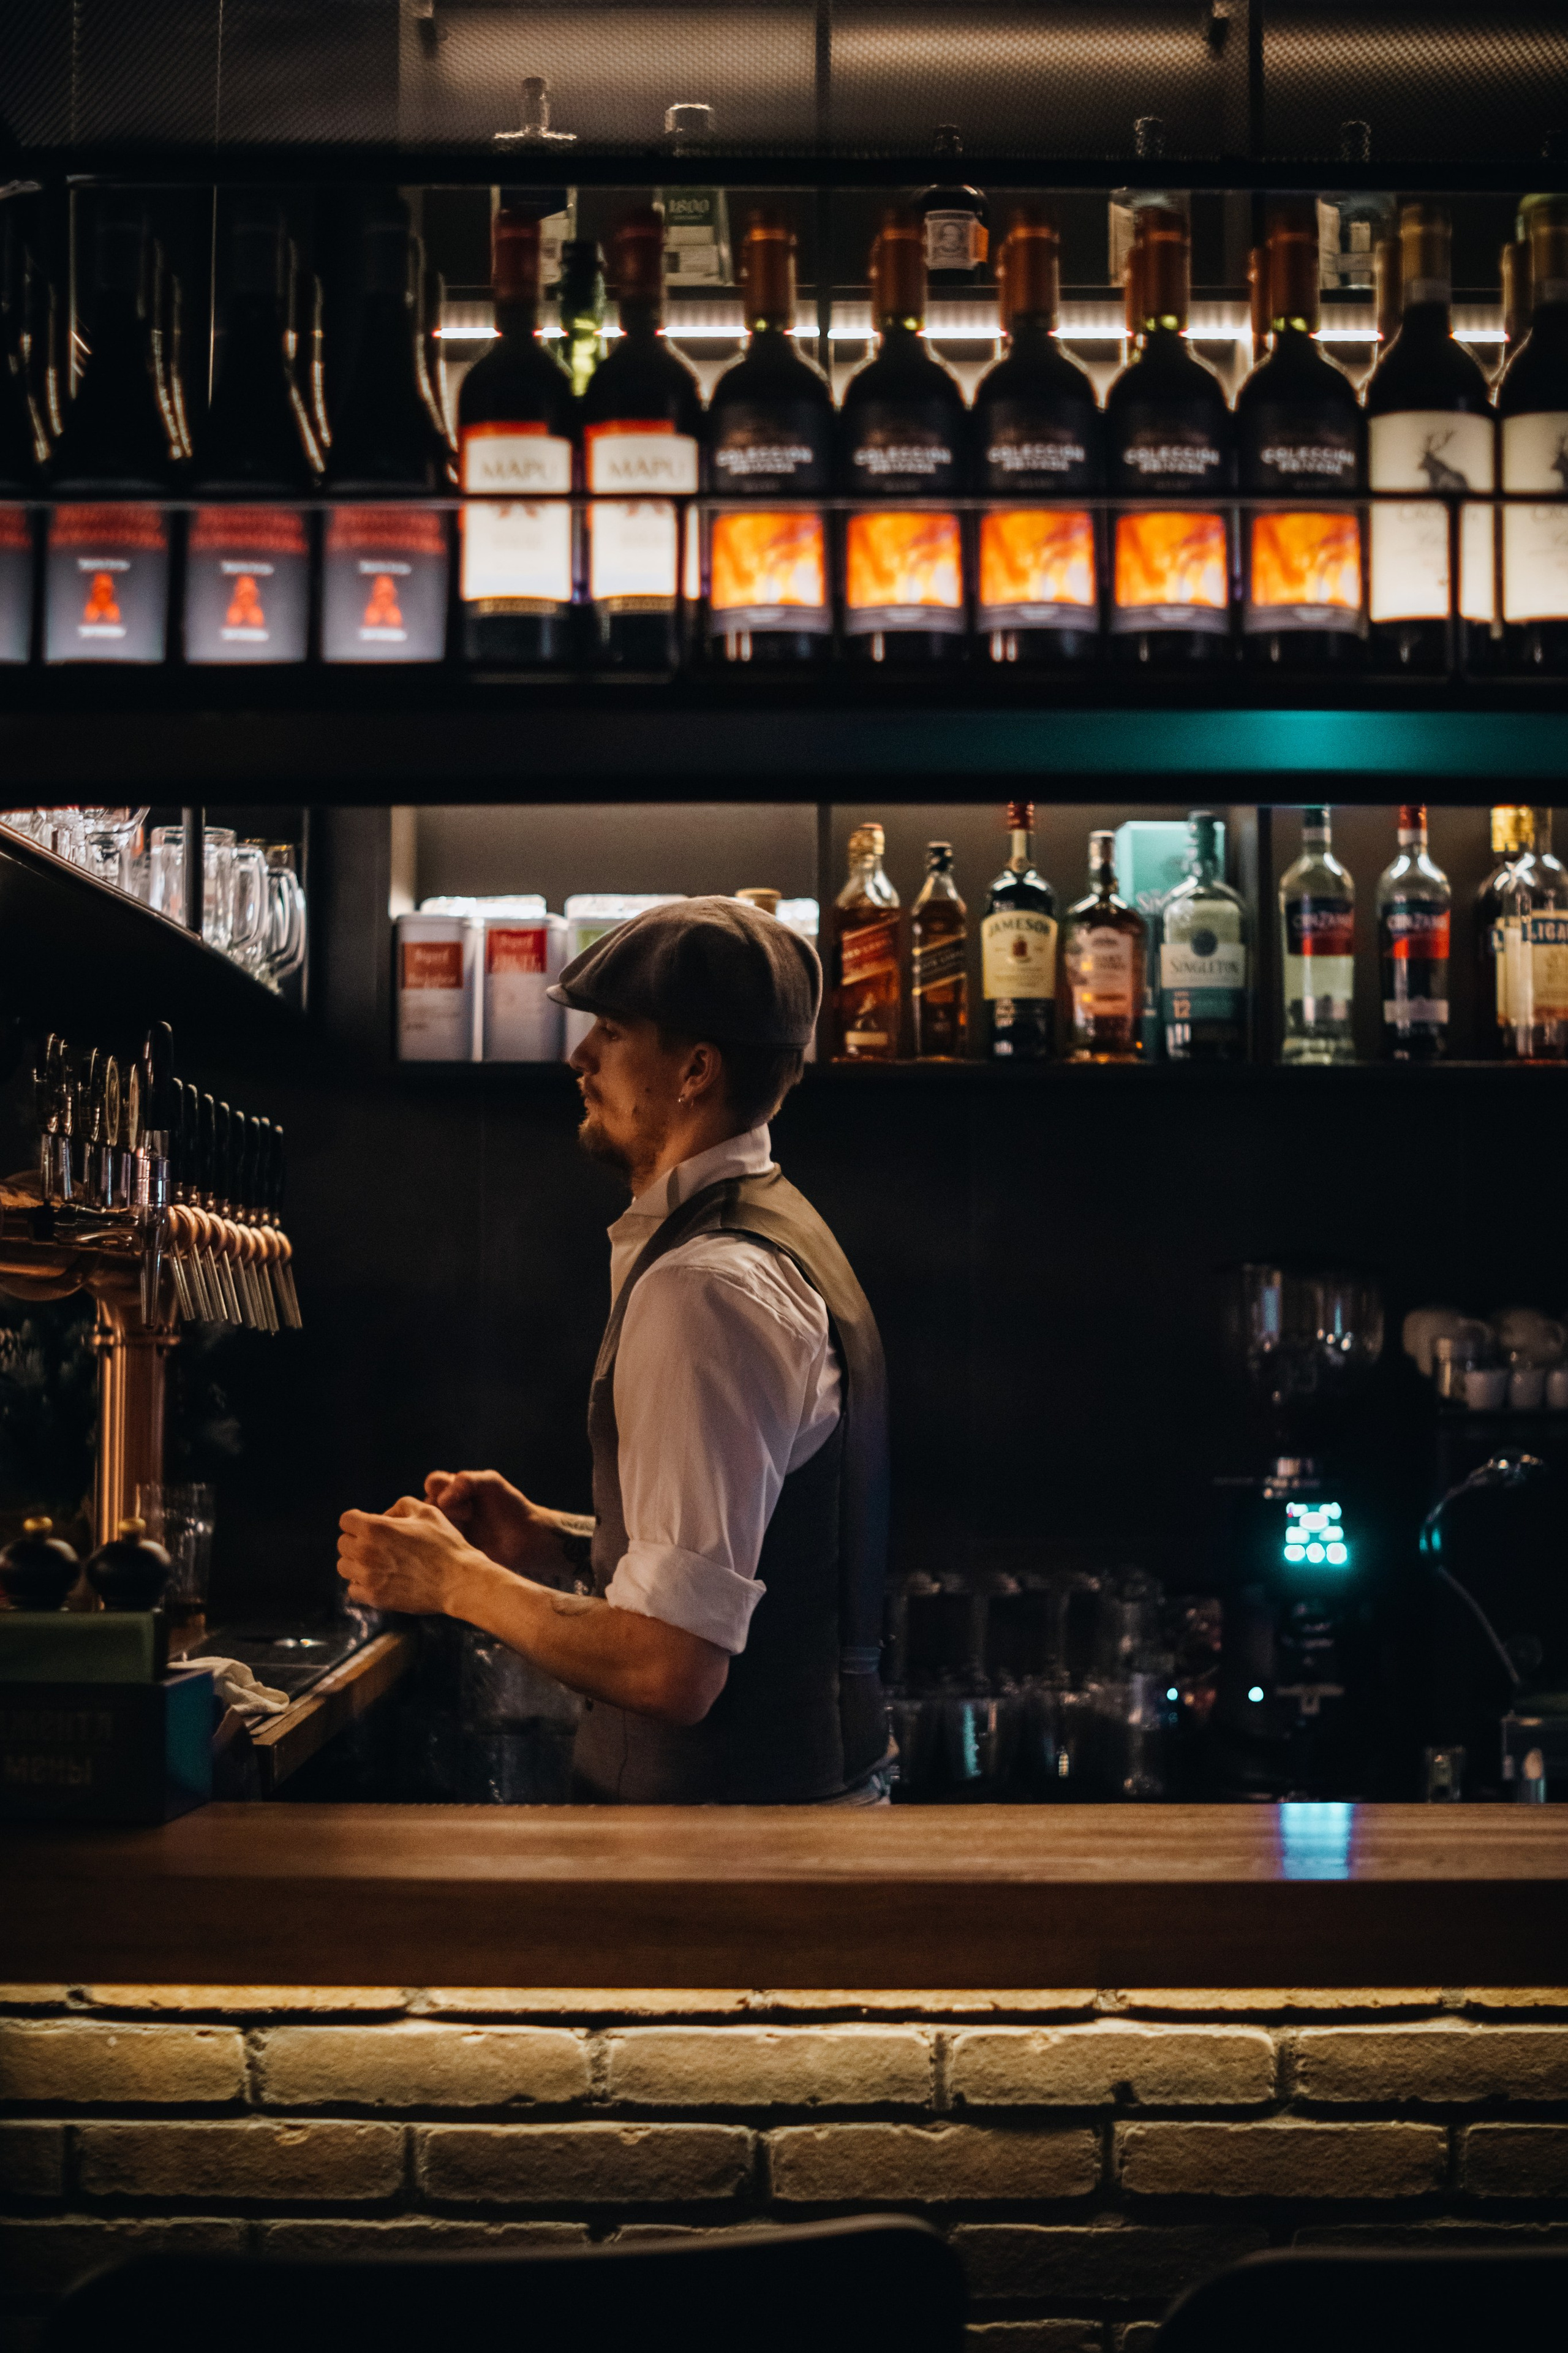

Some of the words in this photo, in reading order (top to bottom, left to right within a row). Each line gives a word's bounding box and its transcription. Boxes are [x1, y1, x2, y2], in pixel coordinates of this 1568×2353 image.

[668, 199, 710, 213] 1800
[481, 459, 557, 481] MAPU
[609, 458, 684, 479] MAPU
[988, 918, 1050, 937] JAMESON
[1170, 959, 1240, 974] SINGLETON
[1173, 999, 1191, 1018] 12
